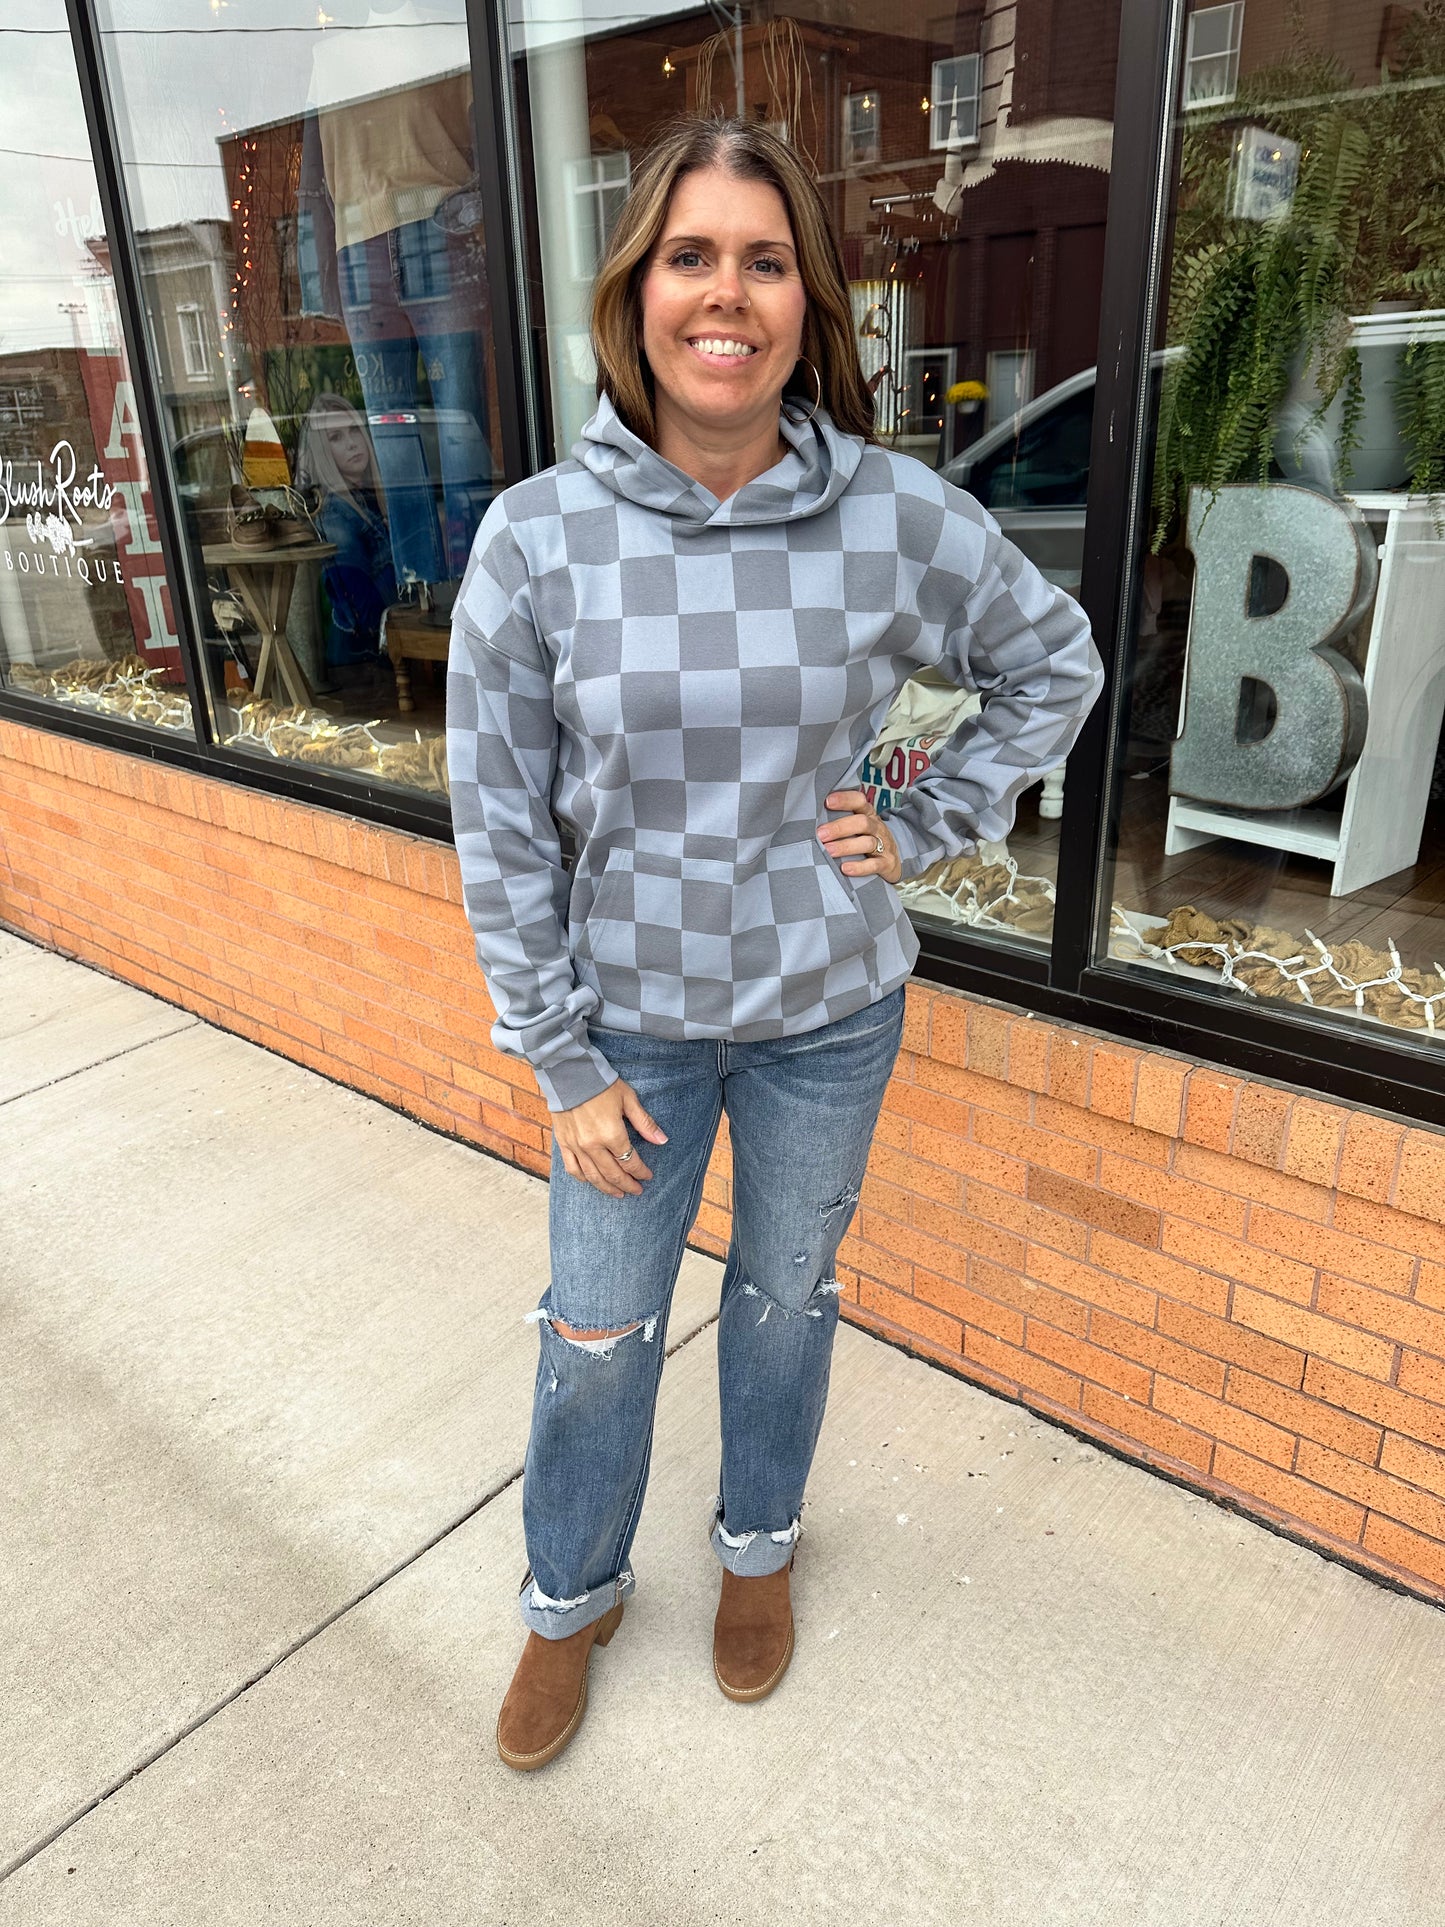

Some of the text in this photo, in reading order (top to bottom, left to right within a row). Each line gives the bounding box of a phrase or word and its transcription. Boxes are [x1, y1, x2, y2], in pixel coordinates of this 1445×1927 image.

[53, 193, 107, 250] Hel
[50, 440, 117, 526] Roots
[4, 550, 125, 586] BOUTIQUE
[1168, 483, 1371, 811] B
